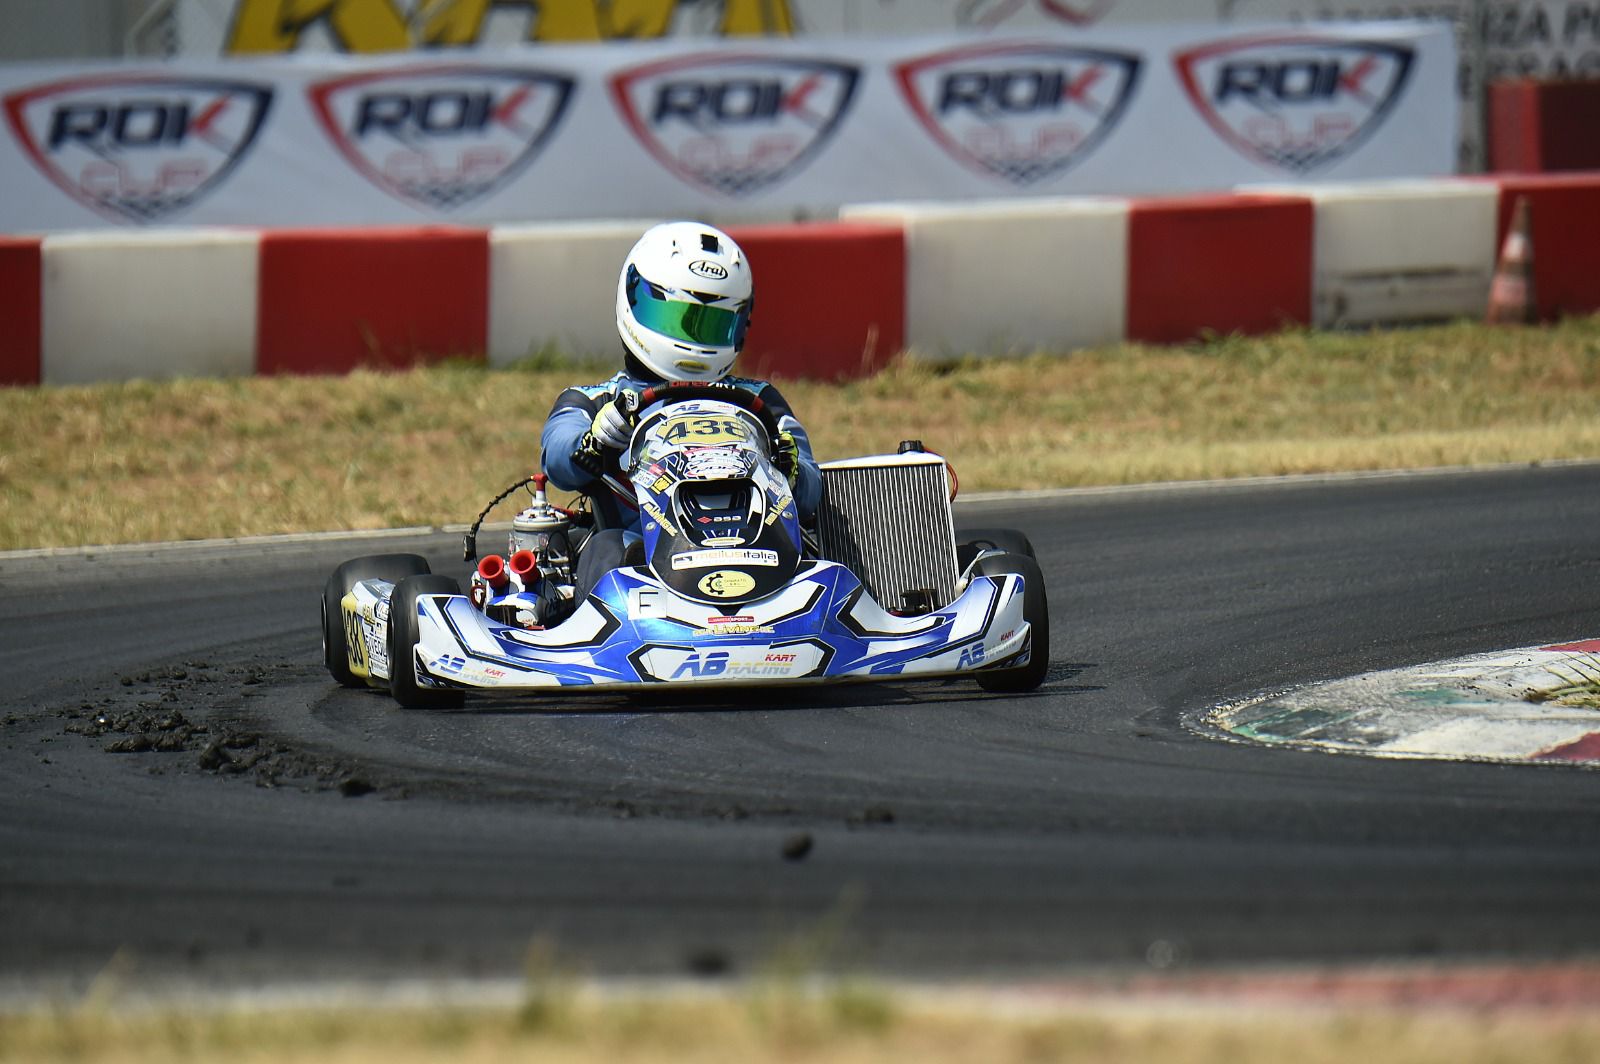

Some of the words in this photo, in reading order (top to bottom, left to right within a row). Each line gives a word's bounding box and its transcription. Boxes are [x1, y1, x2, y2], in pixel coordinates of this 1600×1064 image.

[937, 63, 1108, 122] ROK
[1215, 53, 1380, 108] ROK
[352, 82, 538, 142] ROK
[653, 70, 830, 132] ROK
[48, 95, 237, 152] ROK
[692, 261, 724, 276] Arai
[662, 419, 747, 444] 438
[638, 592, 659, 615] F
[1000, 630, 1015, 641] KART
[728, 662, 793, 675] RACING
[765, 654, 797, 662] KART
[484, 667, 507, 677] KART
